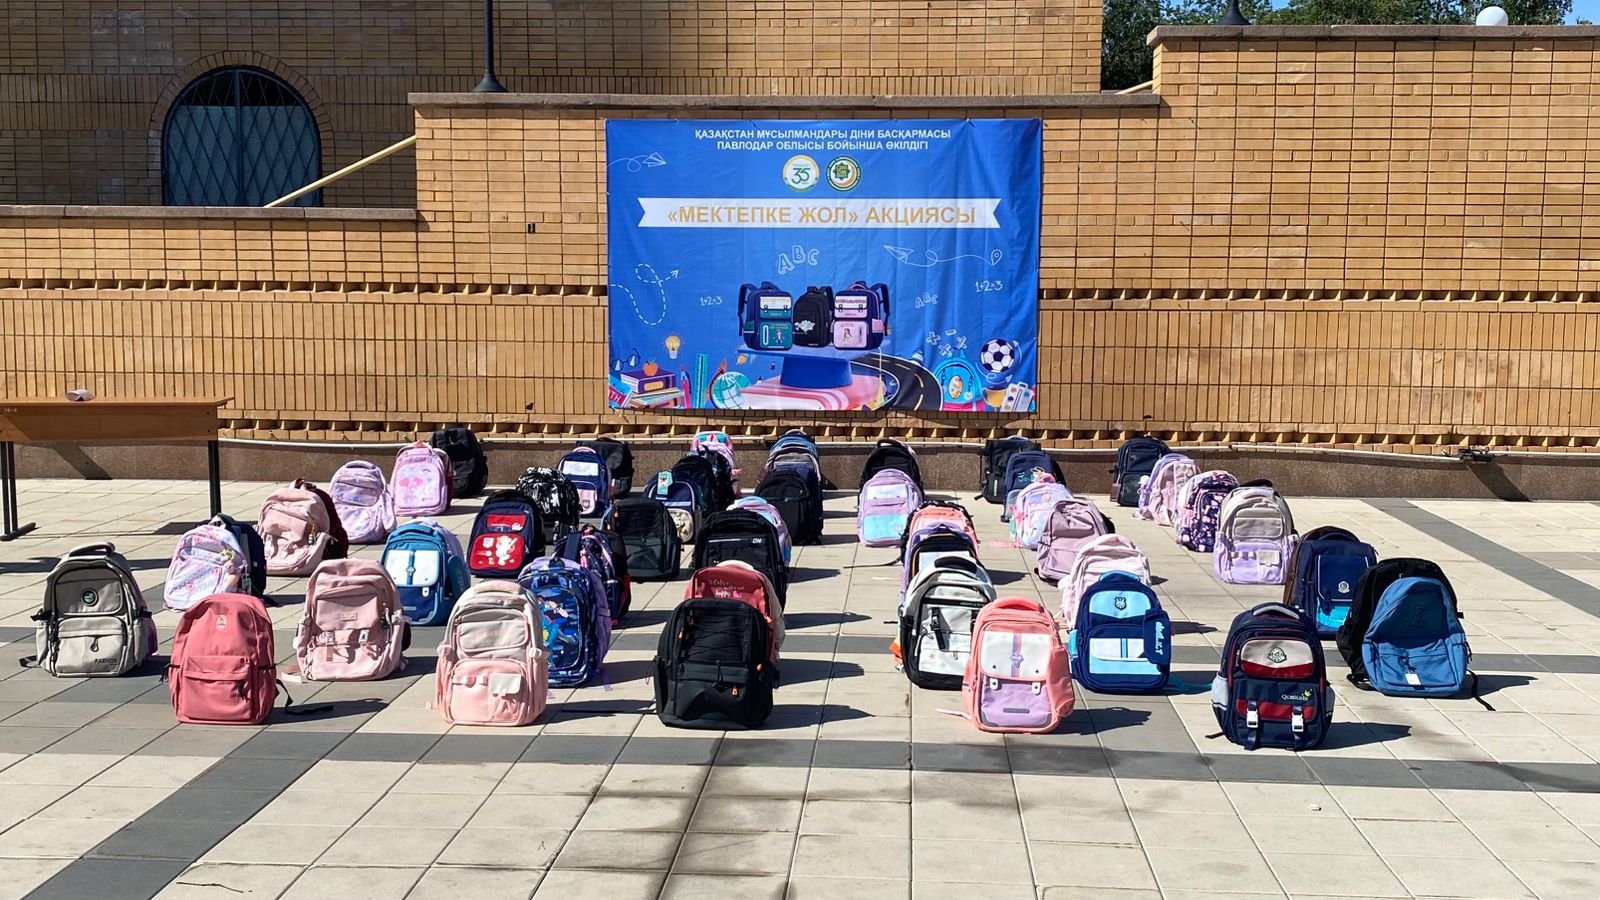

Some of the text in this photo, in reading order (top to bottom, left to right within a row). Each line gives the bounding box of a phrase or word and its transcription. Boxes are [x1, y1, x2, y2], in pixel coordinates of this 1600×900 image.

[695, 130, 951, 139] ҚАЗАҚСТАН МҰСЫЛМАНДАРЫ ДІНИ БАСҚАРМАСЫ
[717, 140, 929, 151] ПАВЛОДАР ОБЛЫСЫ БОЙЫНША ӨКІЛДІГІ
[791, 167, 811, 184] 35
[667, 205, 976, 226] «МЕКТЕПКЕ ЖОЛ» АКЦИЯСЫ
[778, 245, 820, 275] ABC
